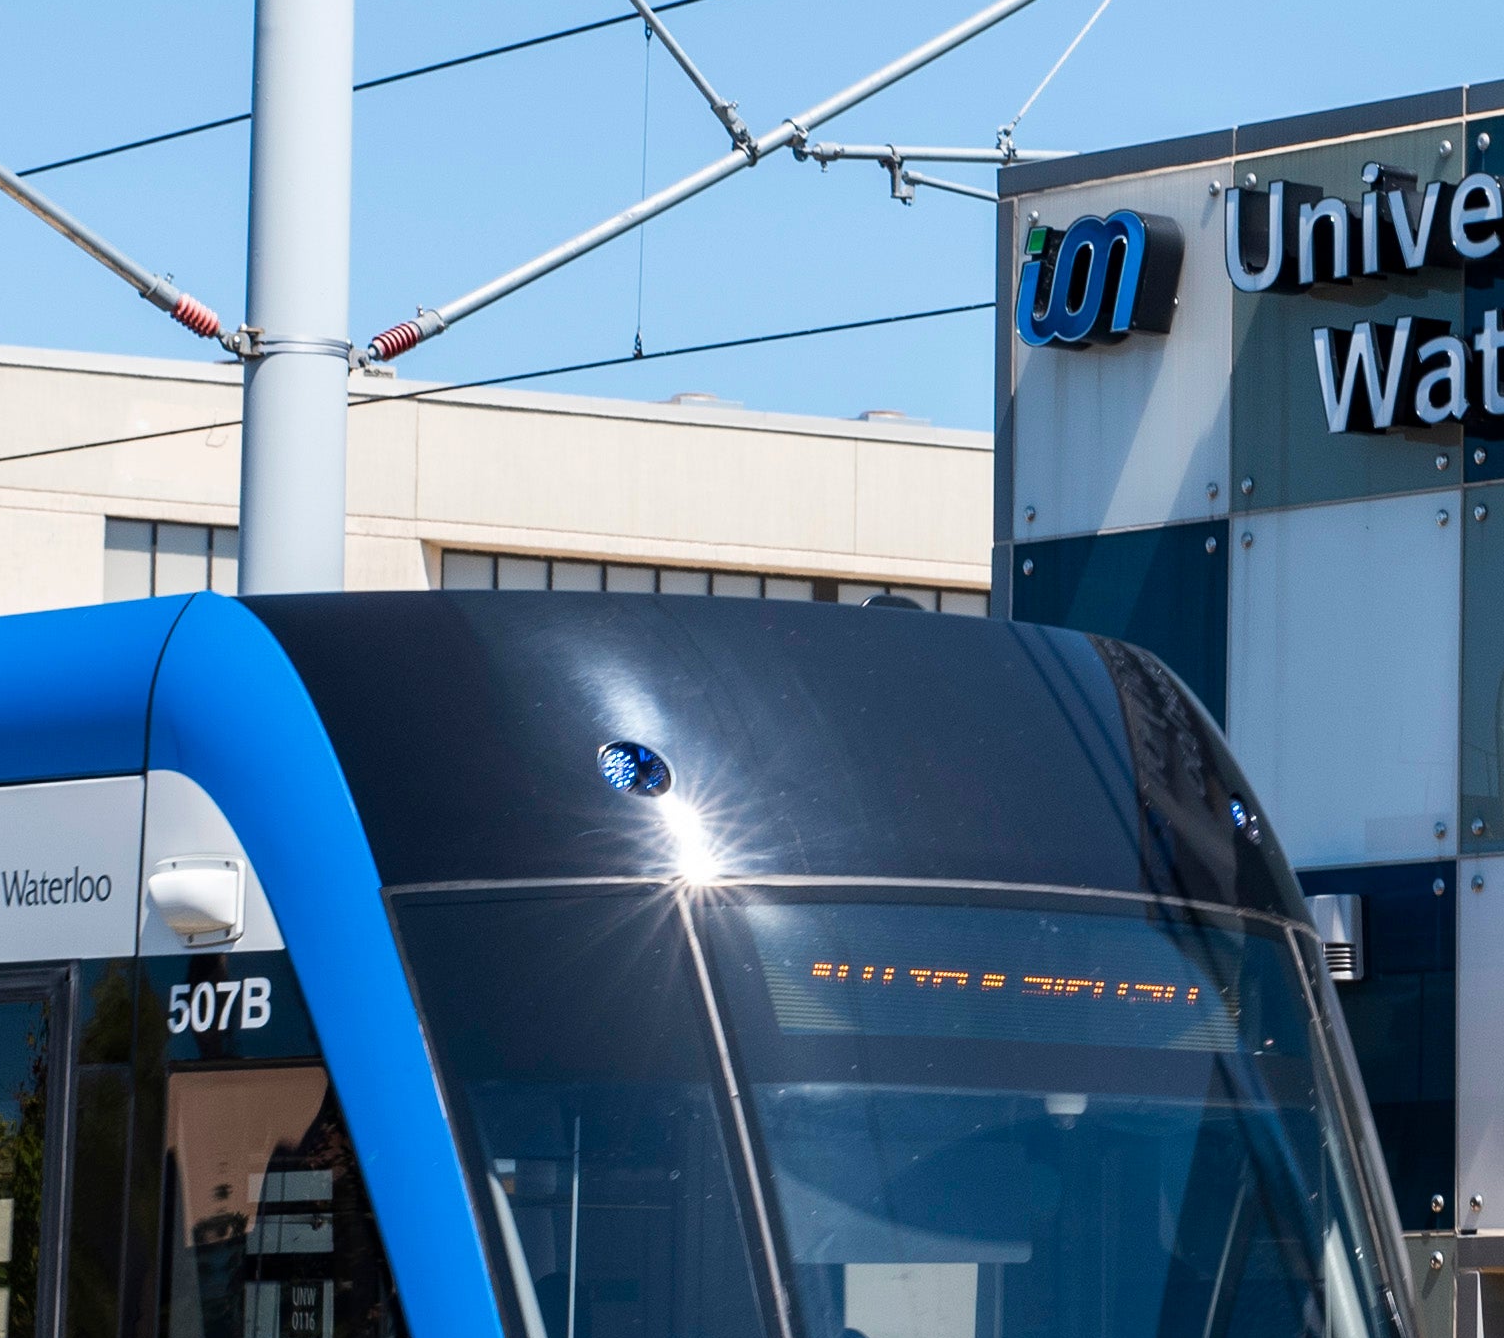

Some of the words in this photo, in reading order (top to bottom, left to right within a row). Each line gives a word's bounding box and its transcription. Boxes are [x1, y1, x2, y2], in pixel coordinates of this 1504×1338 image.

[2, 866, 112, 907] Waterloo
[167, 977, 272, 1035] 507B
[291, 1311, 316, 1331] 0116
